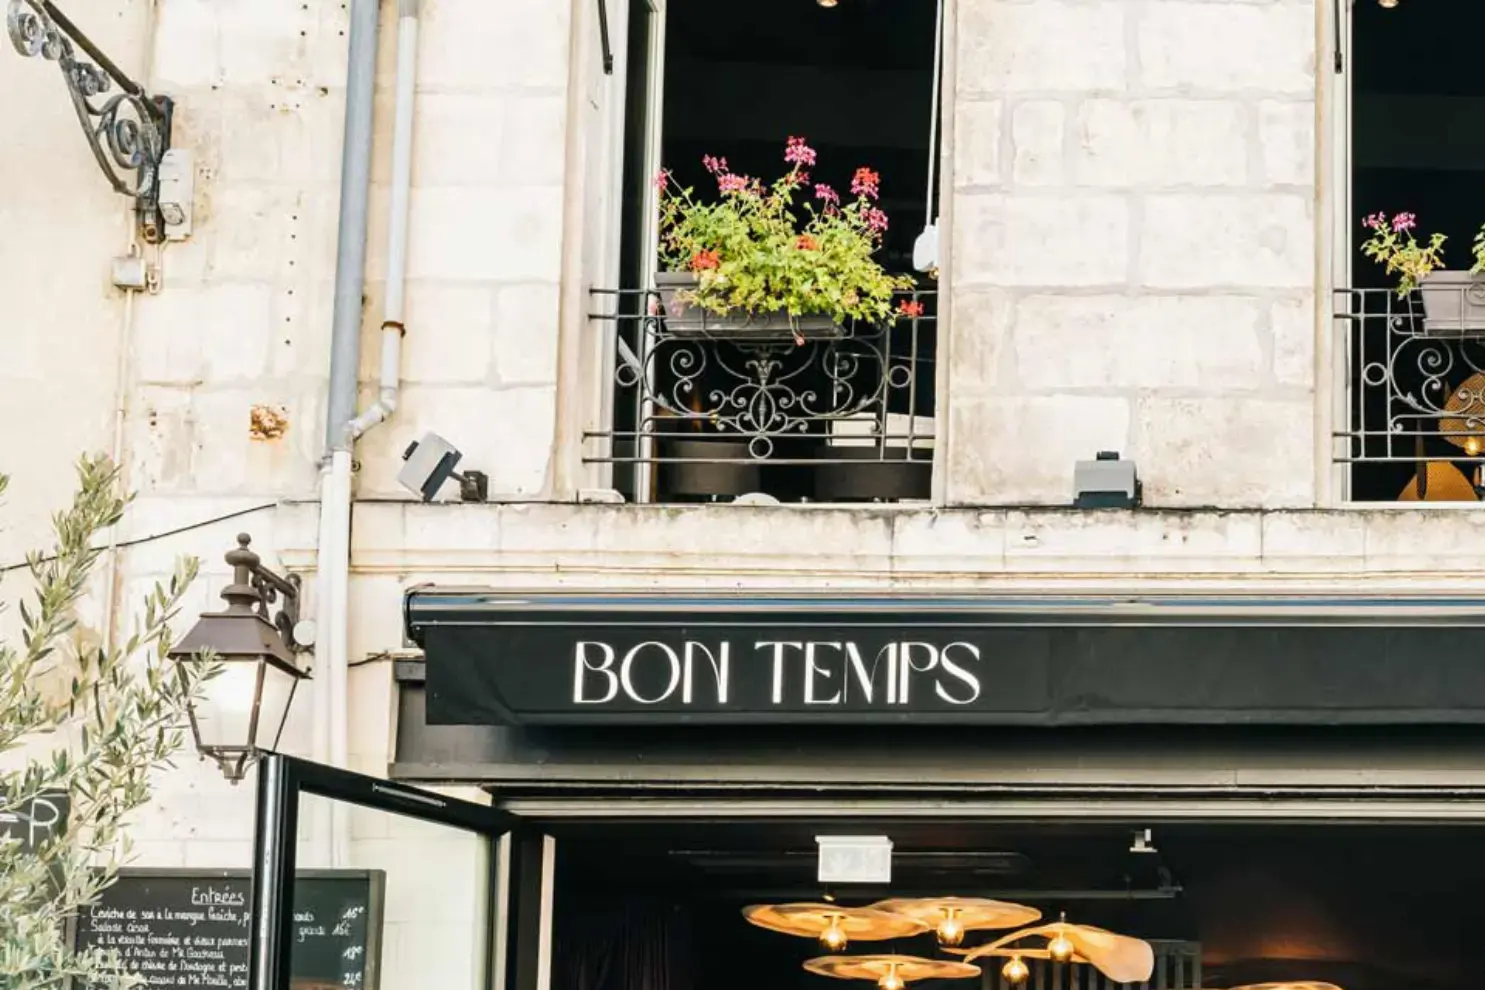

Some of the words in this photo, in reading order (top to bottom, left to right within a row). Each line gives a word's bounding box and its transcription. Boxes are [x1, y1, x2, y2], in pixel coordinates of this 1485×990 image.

[573, 641, 729, 704] BON
[755, 641, 982, 705] TEMPS
[191, 885, 244, 906] Entrées
